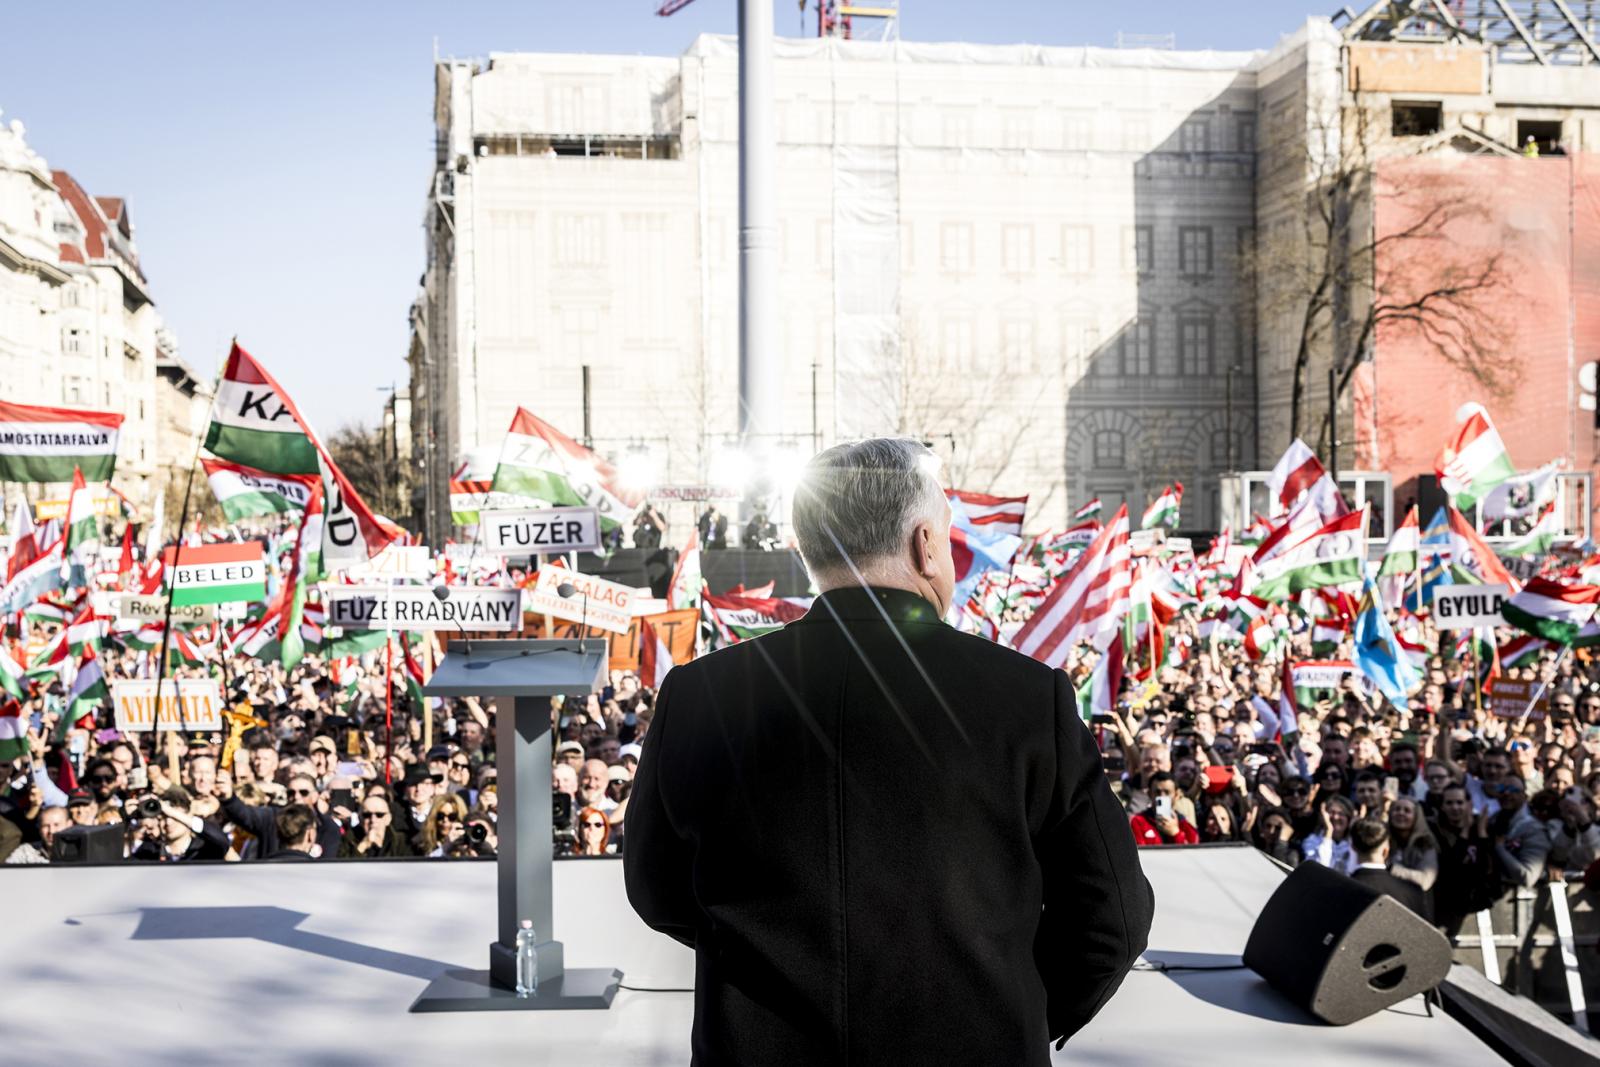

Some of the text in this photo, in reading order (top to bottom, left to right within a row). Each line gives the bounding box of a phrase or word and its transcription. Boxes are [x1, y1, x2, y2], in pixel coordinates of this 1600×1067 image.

[498, 515, 583, 546] FÜZÉR
[178, 565, 254, 584] BELED
[1438, 593, 1503, 617] GYULA
[121, 687, 214, 723] NYÍRKÁTA
